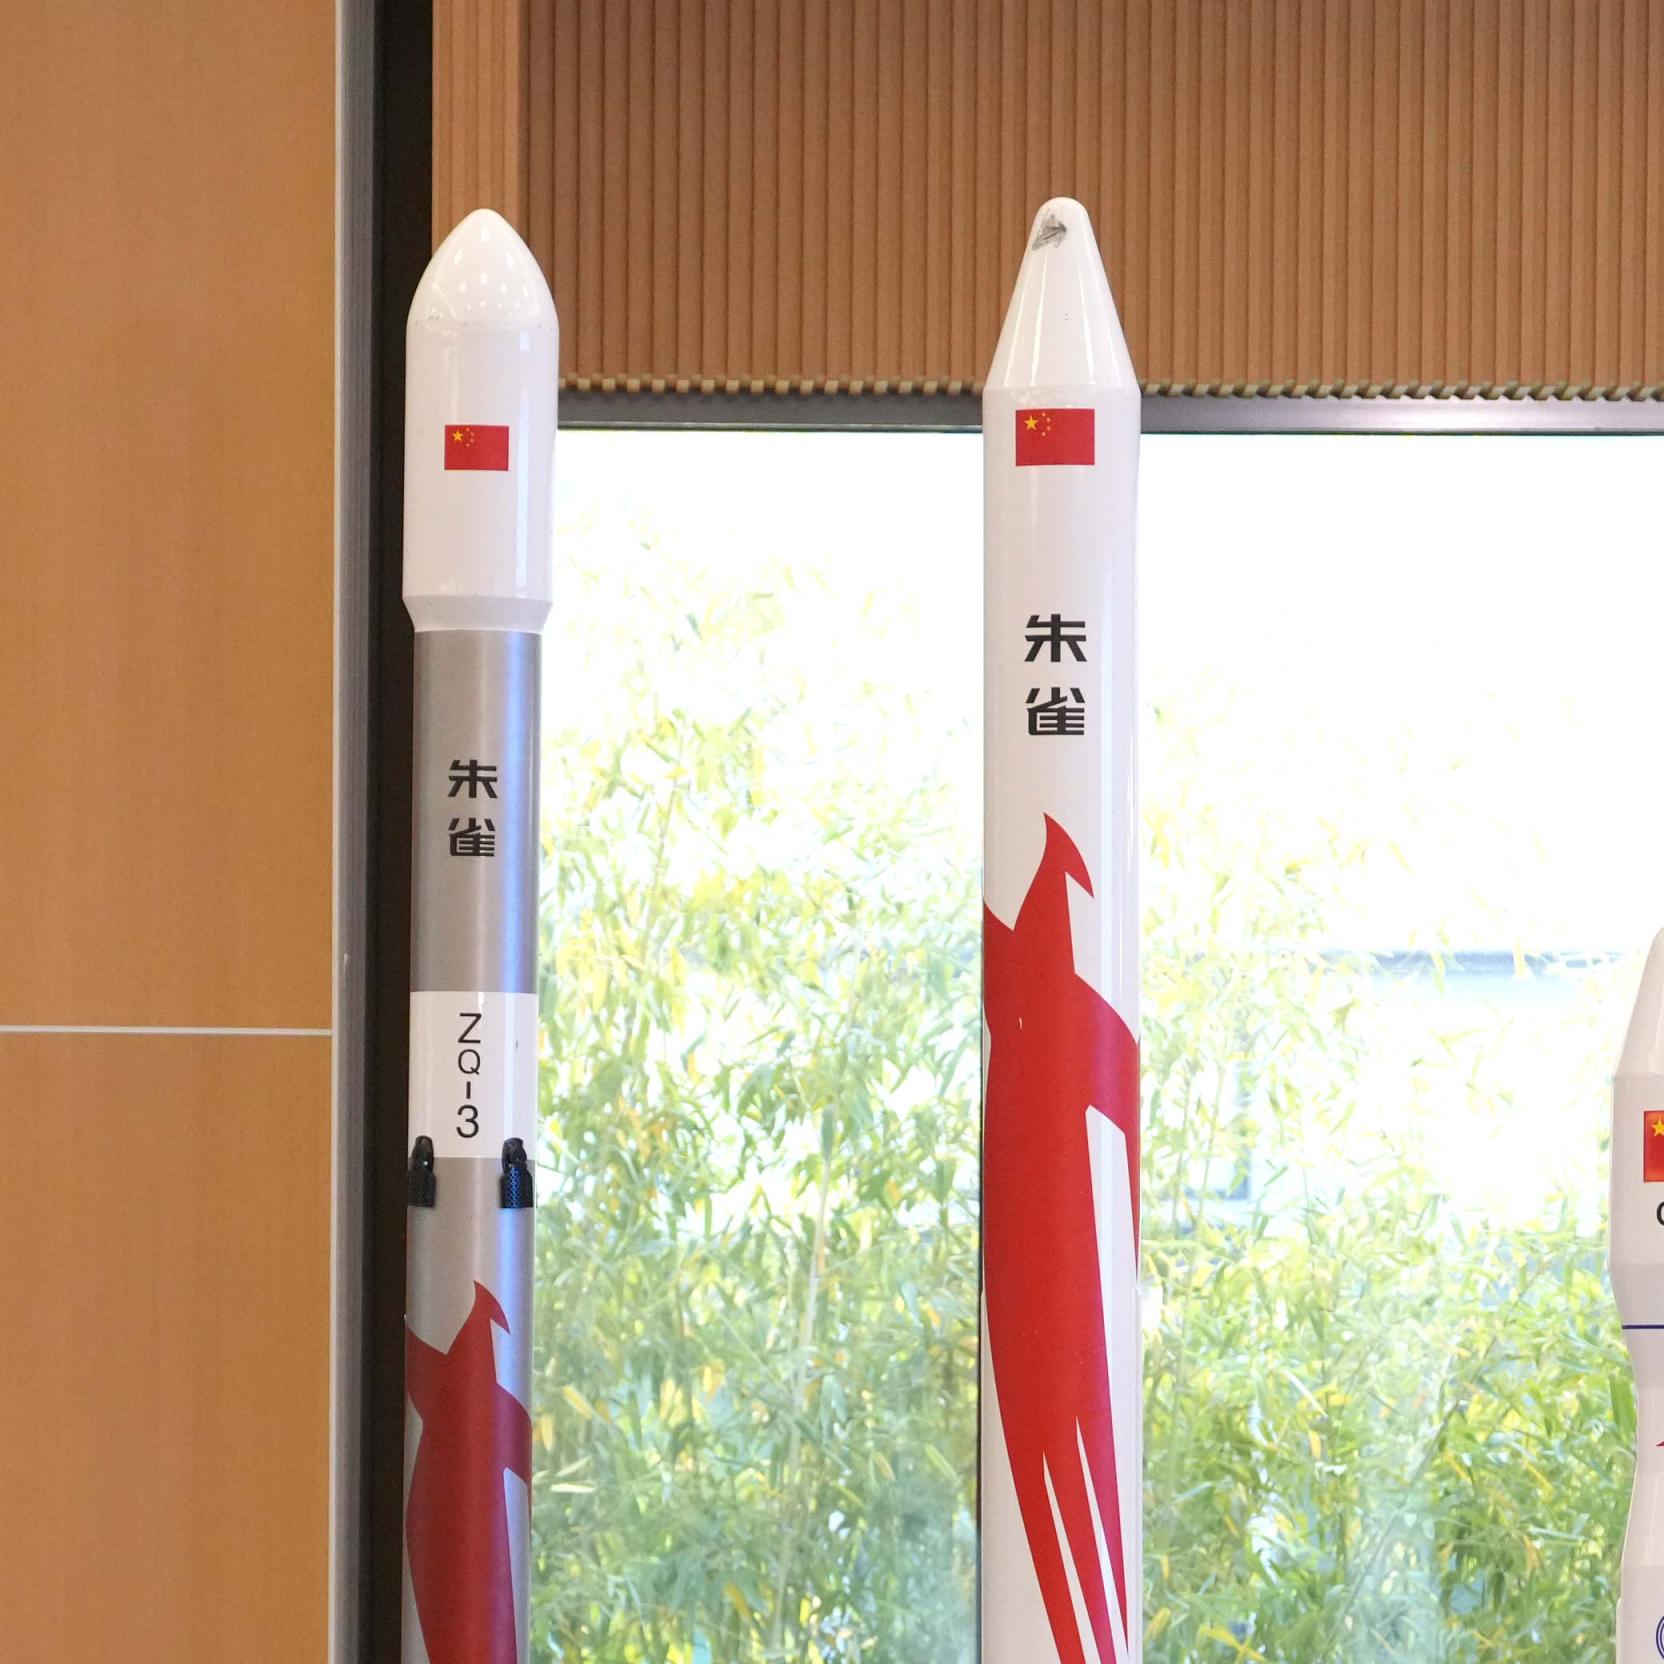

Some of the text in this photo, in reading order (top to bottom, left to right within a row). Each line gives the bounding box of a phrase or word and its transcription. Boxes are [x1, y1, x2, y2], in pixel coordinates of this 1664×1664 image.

[1023, 613, 1087, 736] 朱雀
[447, 759, 498, 857] 朱雀
[456, 1012, 482, 1138] ZQ-3
